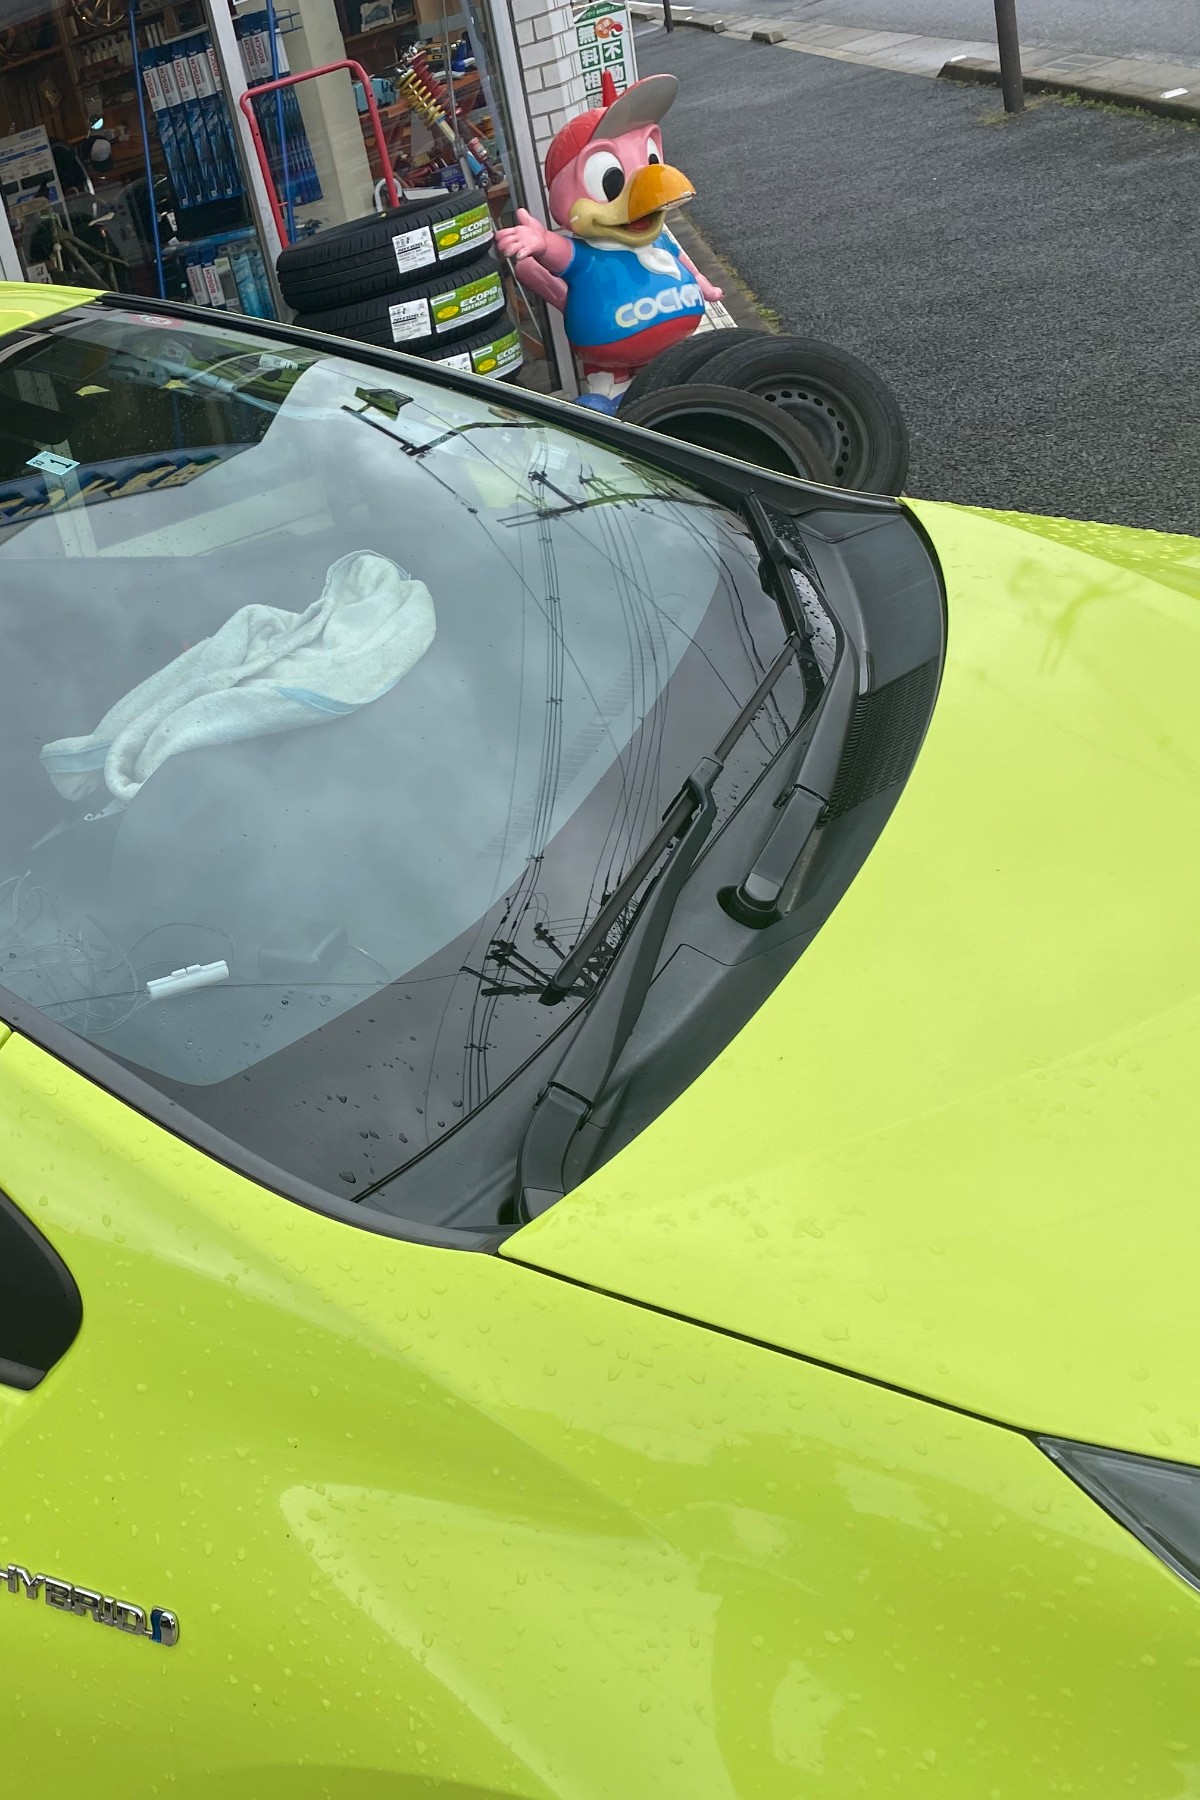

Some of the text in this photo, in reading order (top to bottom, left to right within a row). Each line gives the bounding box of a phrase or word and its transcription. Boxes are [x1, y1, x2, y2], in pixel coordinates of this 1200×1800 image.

[160, 68, 170, 94] BOSCH
[175, 62, 186, 88] BOSCH
[190, 58, 201, 85] BOSCH
[603, 41, 626, 95] 不動
[145, 72, 155, 99] BOSCH
[205, 269, 216, 294] BOSCH
[460, 286, 498, 308] ECOPIA
